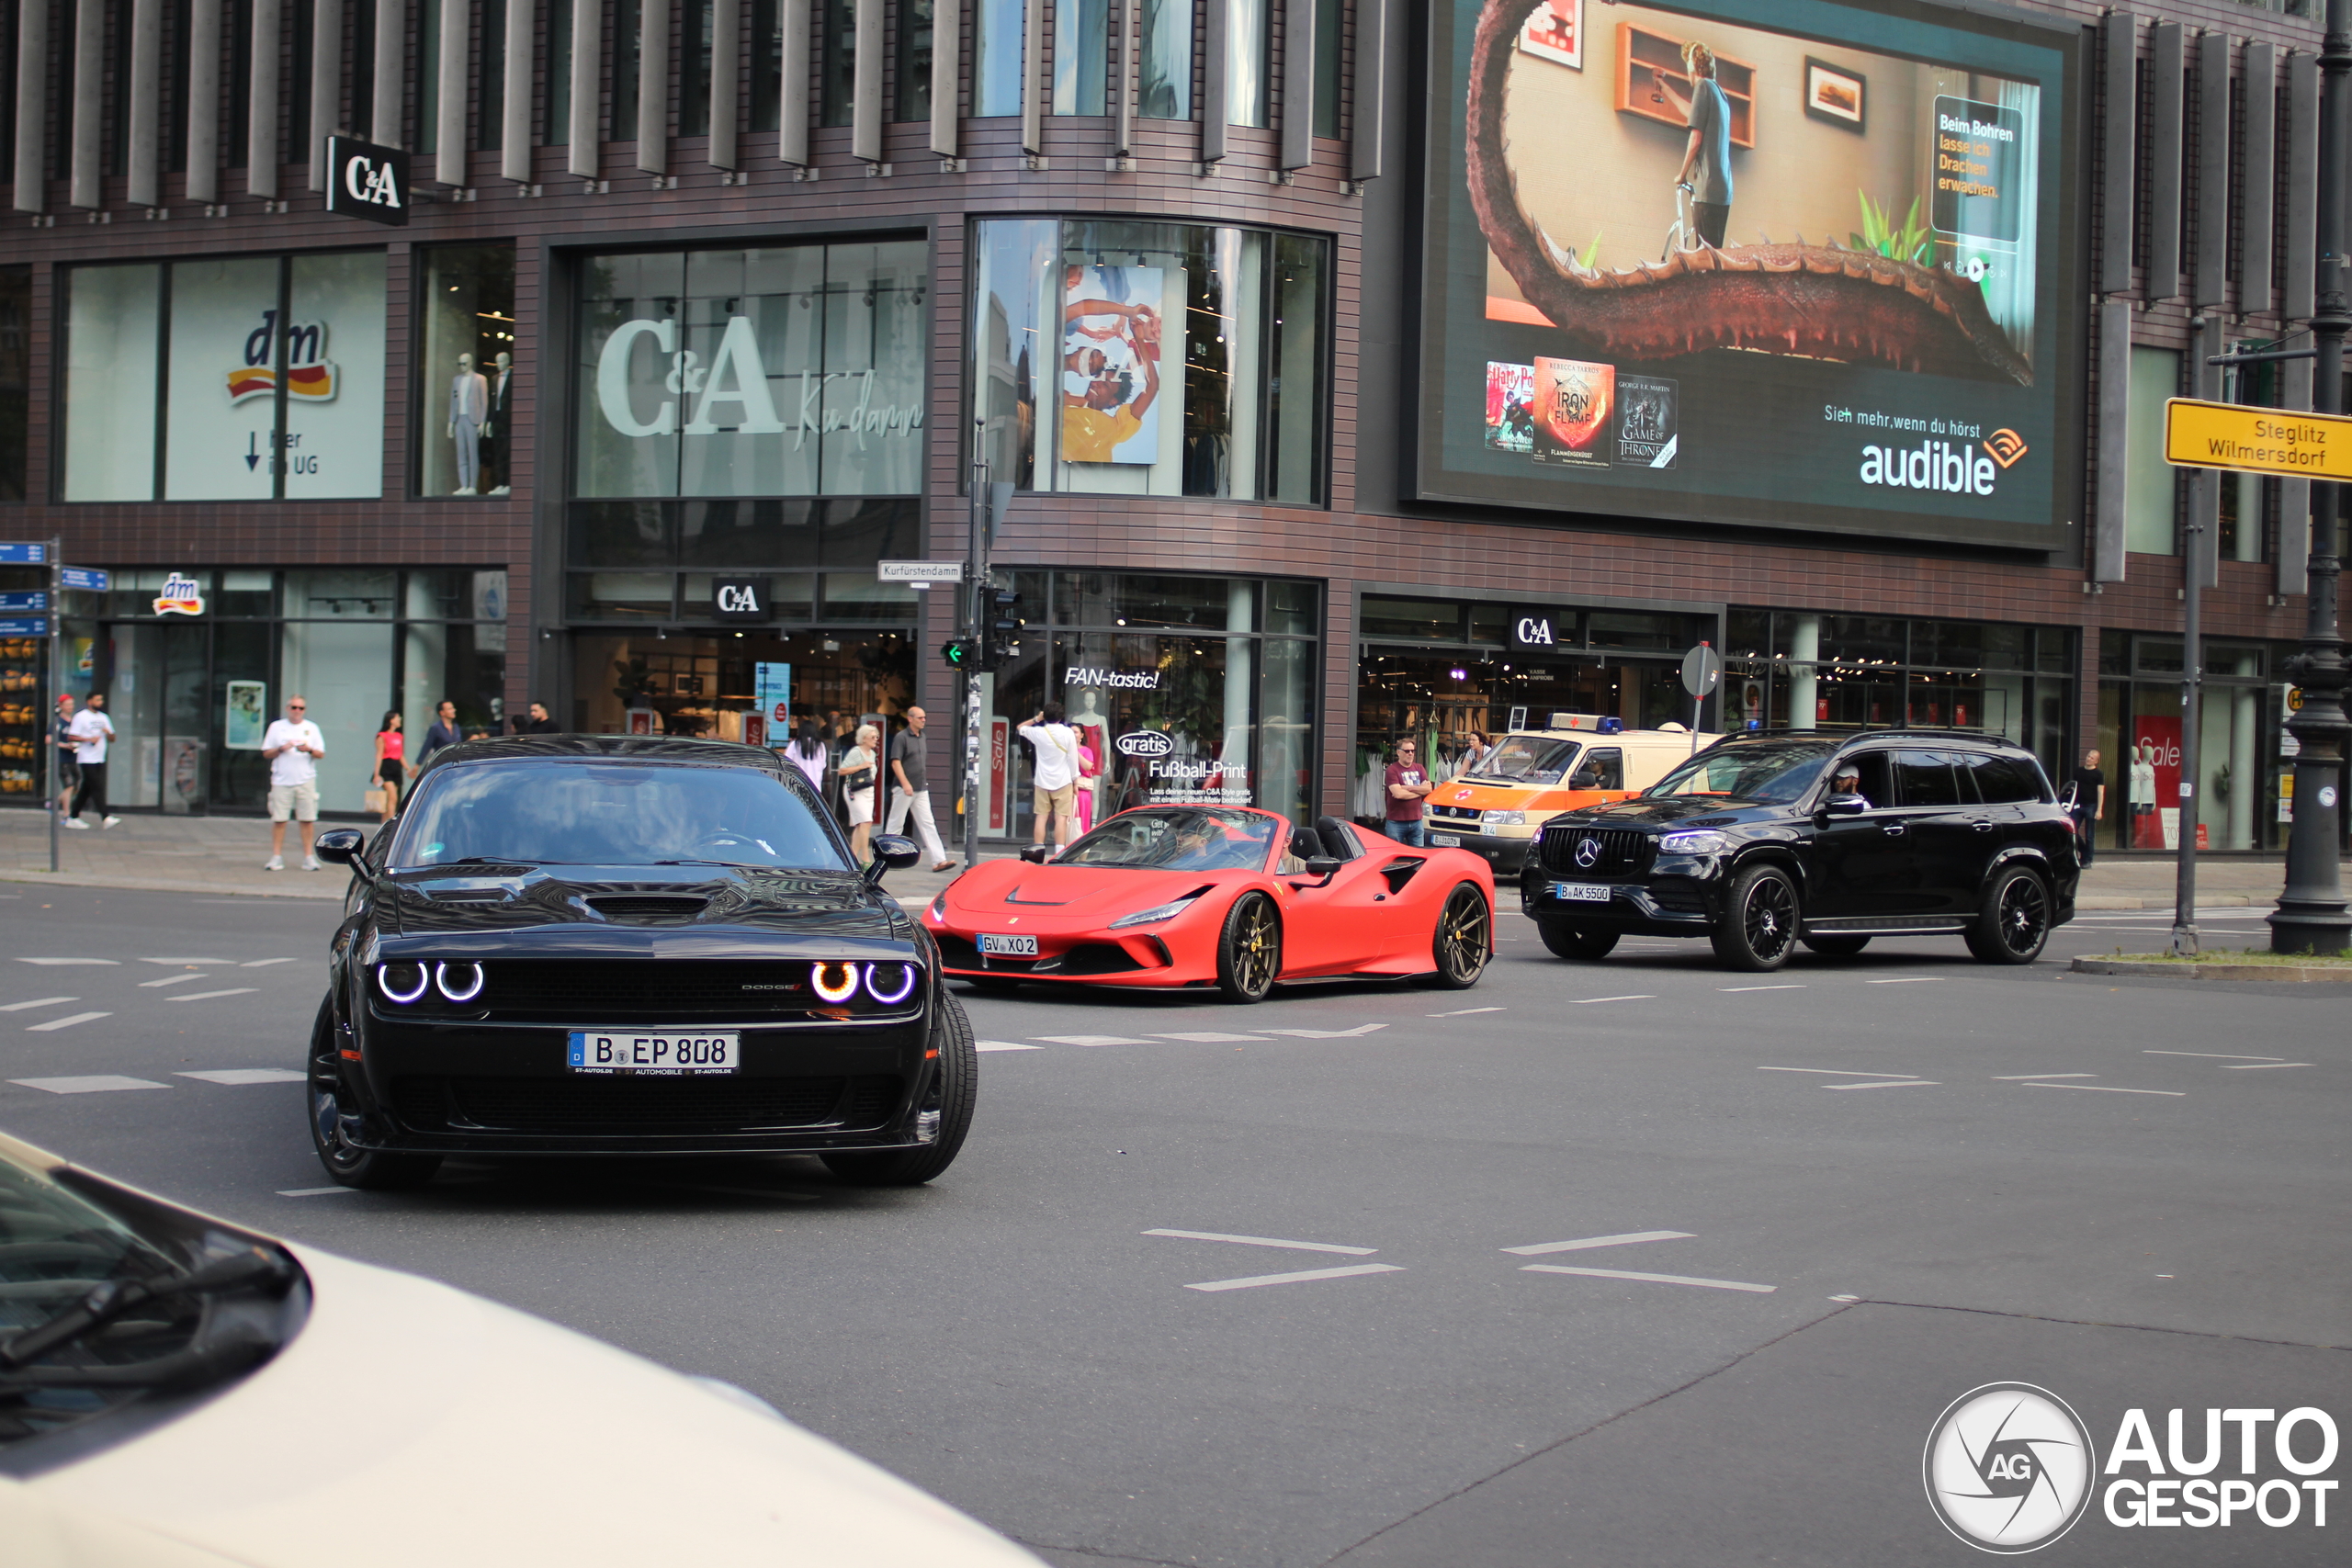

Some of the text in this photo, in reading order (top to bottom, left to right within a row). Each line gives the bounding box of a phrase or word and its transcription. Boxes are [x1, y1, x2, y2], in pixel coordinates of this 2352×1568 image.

[1939, 113, 2014, 142] Beim Bohren
[1939, 134, 1991, 158] lasse ich
[1939, 153, 1988, 176] Drachen
[345, 155, 401, 209] C&A
[1939, 176, 1999, 198] erwachen.
[597, 315, 786, 437] C&A
[1489, 367, 1520, 390] Harry
[1549, 362, 1576, 372] REBECCA
[1619, 380, 1639, 390] GEORGE
[1650, 385, 1670, 393] MARTIN
[1557, 391, 1589, 411] IRON
[1623, 423, 1664, 441] GAME OF
[1825, 404, 1852, 423] Sieh
[1930, 418, 1946, 434] du
[1950, 420, 1981, 439] hörst
[2255, 420, 2326, 446] Steglitz
[2208, 438, 2326, 467] Wilmersdorf
[294, 456, 318, 475] UG
[1860, 439, 1996, 496] audible
[884, 565, 958, 576] Kurfürstendamm
[164, 575, 195, 598] dm
[718, 585, 759, 612] C&A
[1518, 617, 1553, 645] C&A
[1064, 666, 1160, 689] FAN-tastic!
[993, 729, 1004, 772] Sale
[1121, 736, 1167, 754] gratis
[1149, 760, 1247, 779] Fußball-Print
[1221, 788, 1236, 797] Style
[1236, 789, 1250, 797] gratis
[1562, 886, 1608, 899] B AK 5500
[984, 937, 1035, 953] GV XO 2
[597, 1037, 613, 1063] B
[634, 1038, 669, 1064] EP
[676, 1038, 726, 1064] 808
